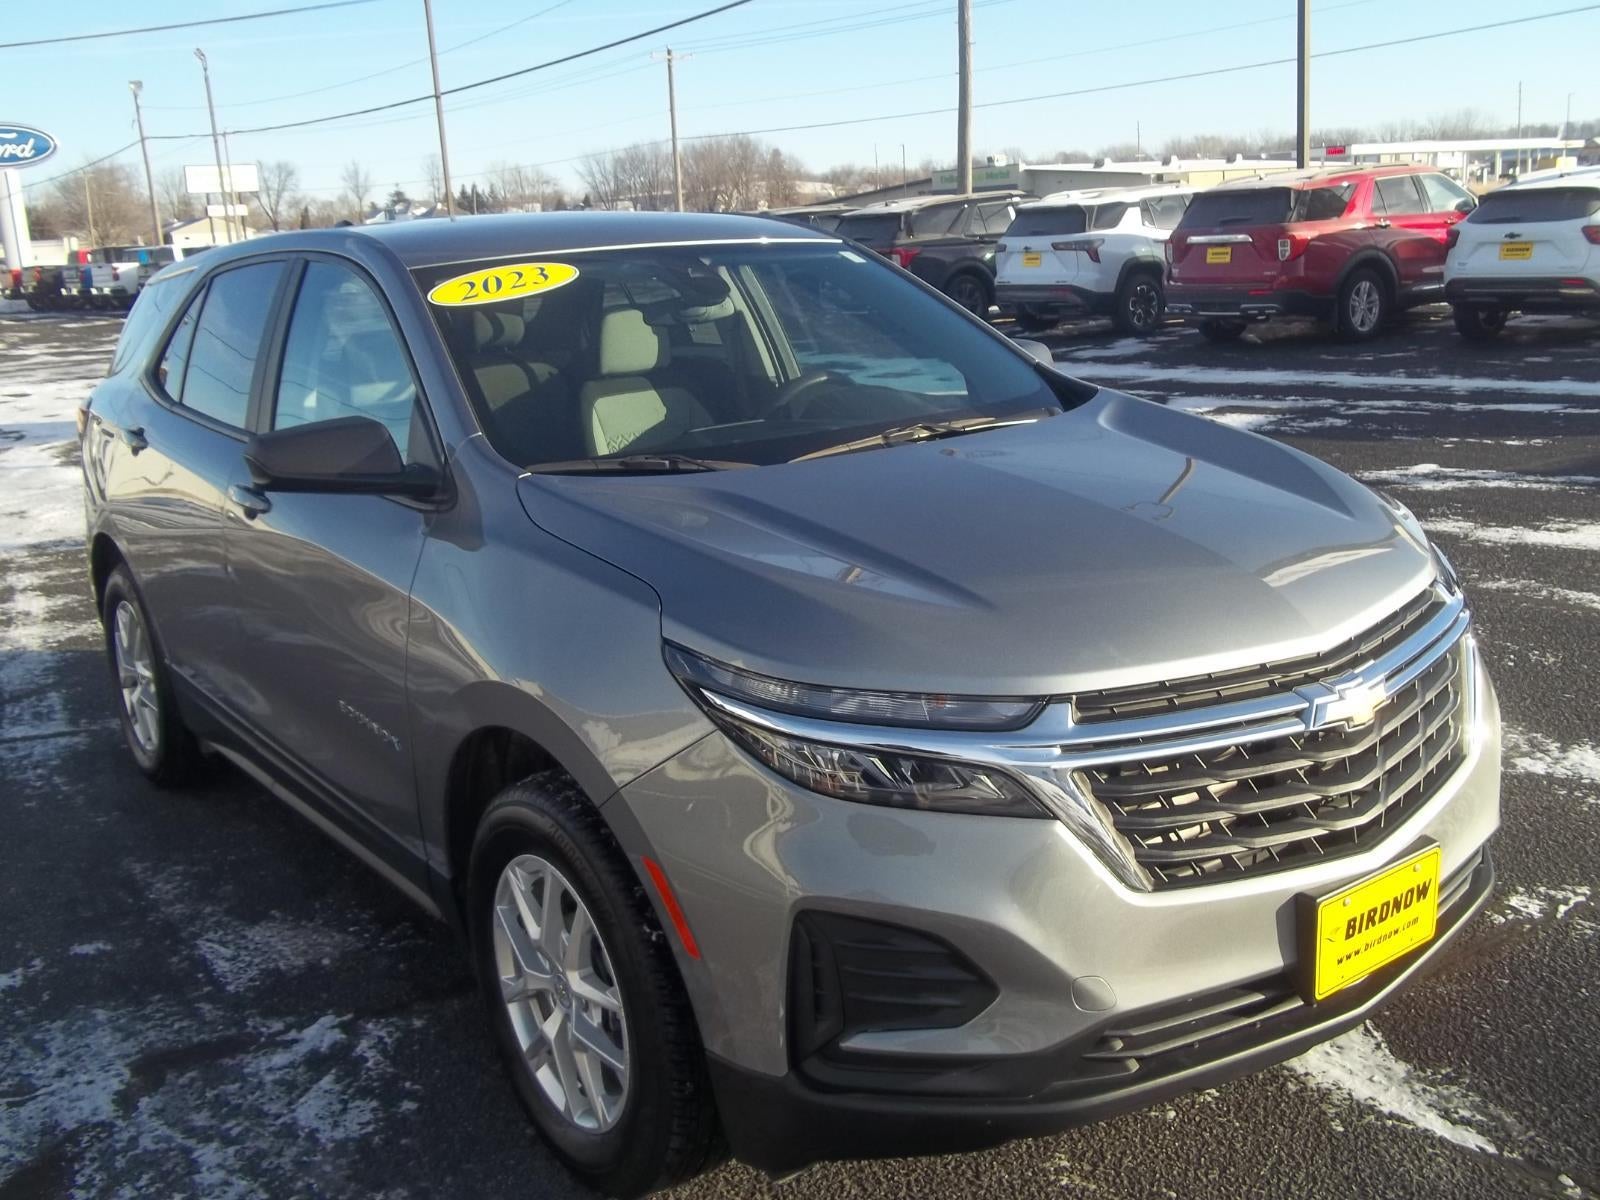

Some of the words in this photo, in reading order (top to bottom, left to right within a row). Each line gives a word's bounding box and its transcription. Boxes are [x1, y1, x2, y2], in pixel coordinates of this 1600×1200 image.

[458, 266, 550, 301] 2023
[1344, 878, 1432, 941] BIRDNOW
[1337, 916, 1419, 964] www.birdnow.com
